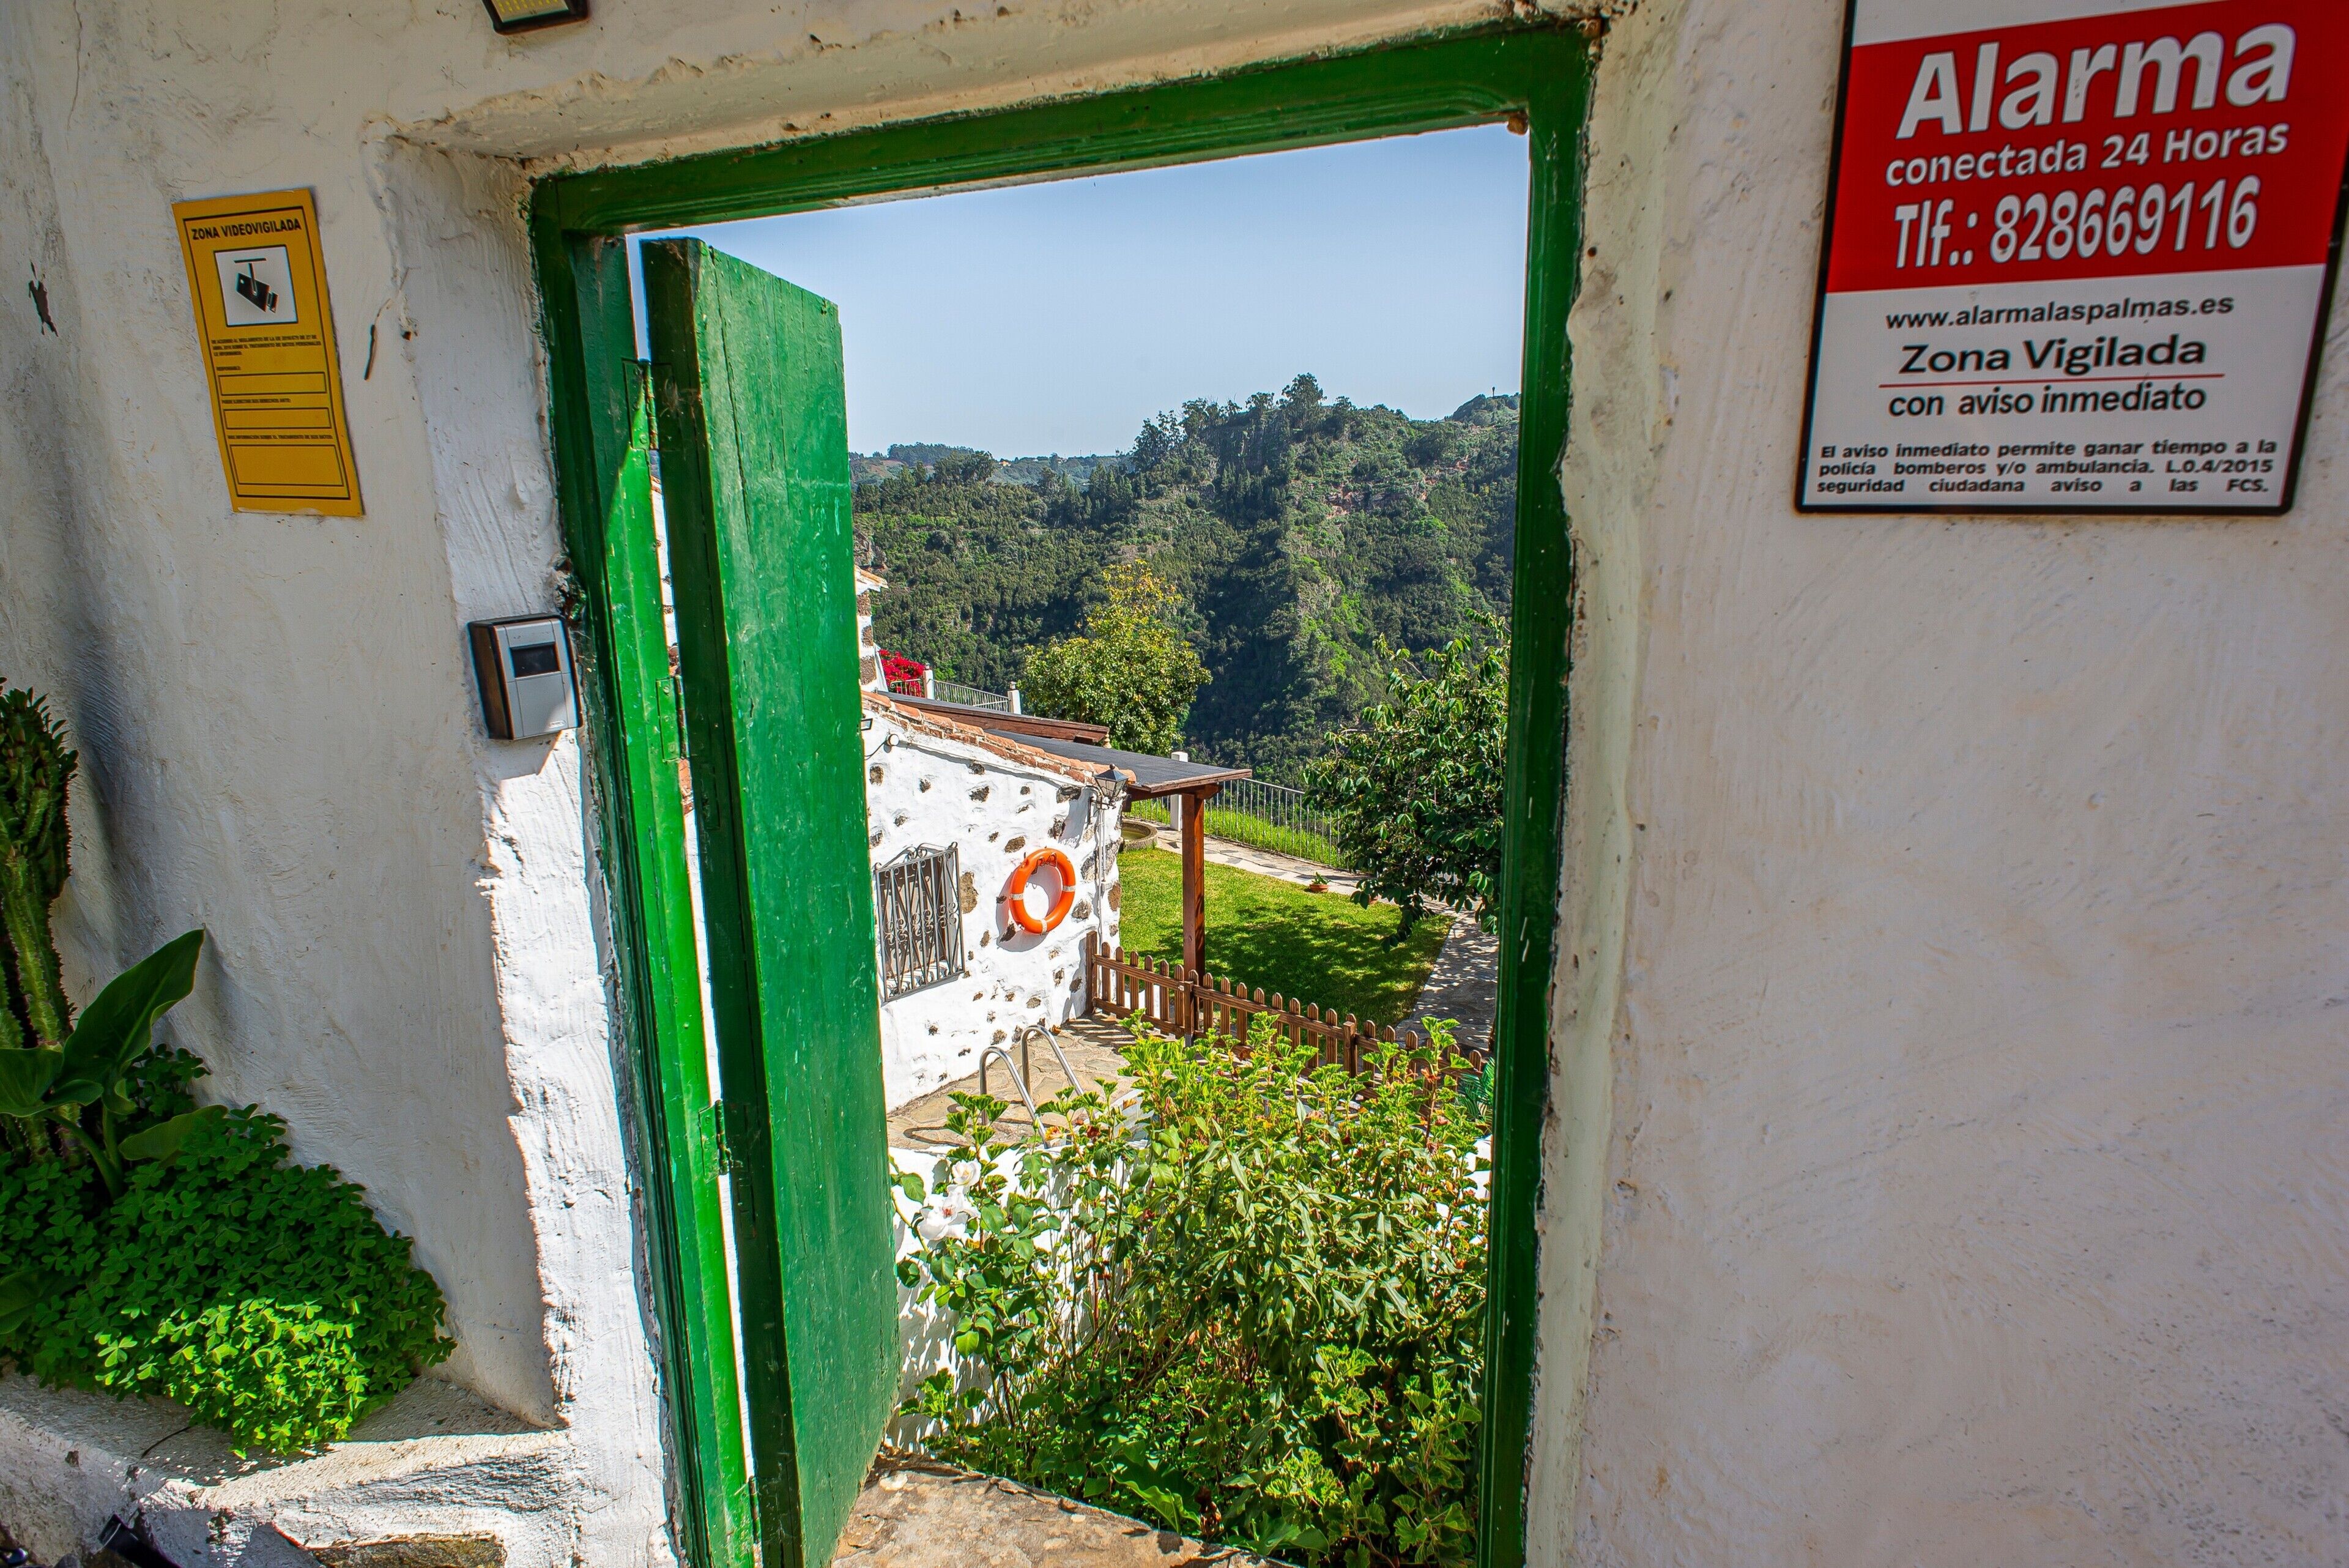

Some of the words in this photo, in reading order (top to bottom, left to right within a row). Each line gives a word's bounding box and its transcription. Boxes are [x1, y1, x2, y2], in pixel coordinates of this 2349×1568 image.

[1895, 23, 2296, 139] Alarma
[1886, 139, 2087, 187] conectada
[2100, 132, 2150, 169] 24
[2163, 123, 2289, 164] Horas
[191, 227, 220, 240] ZONA
[221, 218, 302, 237] VIDEOVIGILADA
[1894, 199, 1979, 269] Tlf.:
[1990, 175, 2262, 266] 828669116
[1886, 296, 2234, 329] www.alarmalaspalmas.es
[1898, 344, 2011, 374] Zona
[2023, 334, 2206, 376] Vigilada
[1888, 393, 1944, 417] con
[1958, 386, 2034, 415] aviso
[2041, 381, 2206, 413] inmediato
[1821, 446, 1835, 458] El
[1842, 444, 1888, 458] aviso
[1896, 443, 1989, 458] inmediato
[1997, 441, 2075, 459] permite
[2084, 443, 2144, 457] ganar
[2151, 439, 2227, 456] tiempo
[2235, 441, 2249, 454] a
[2257, 439, 2277, 454] la
[1893, 462, 1986, 475] bomberos
[1996, 461, 2026, 476] y/o
[2035, 459, 2154, 474] ambulancia.
[1817, 479, 1905, 494] seguridad
[1928, 478, 2025, 492] ciudadana
[2050, 478, 2102, 492] aviso
[2128, 480, 2143, 492] a
[2169, 478, 2199, 492] las
[2225, 478, 2268, 492] FCS.
